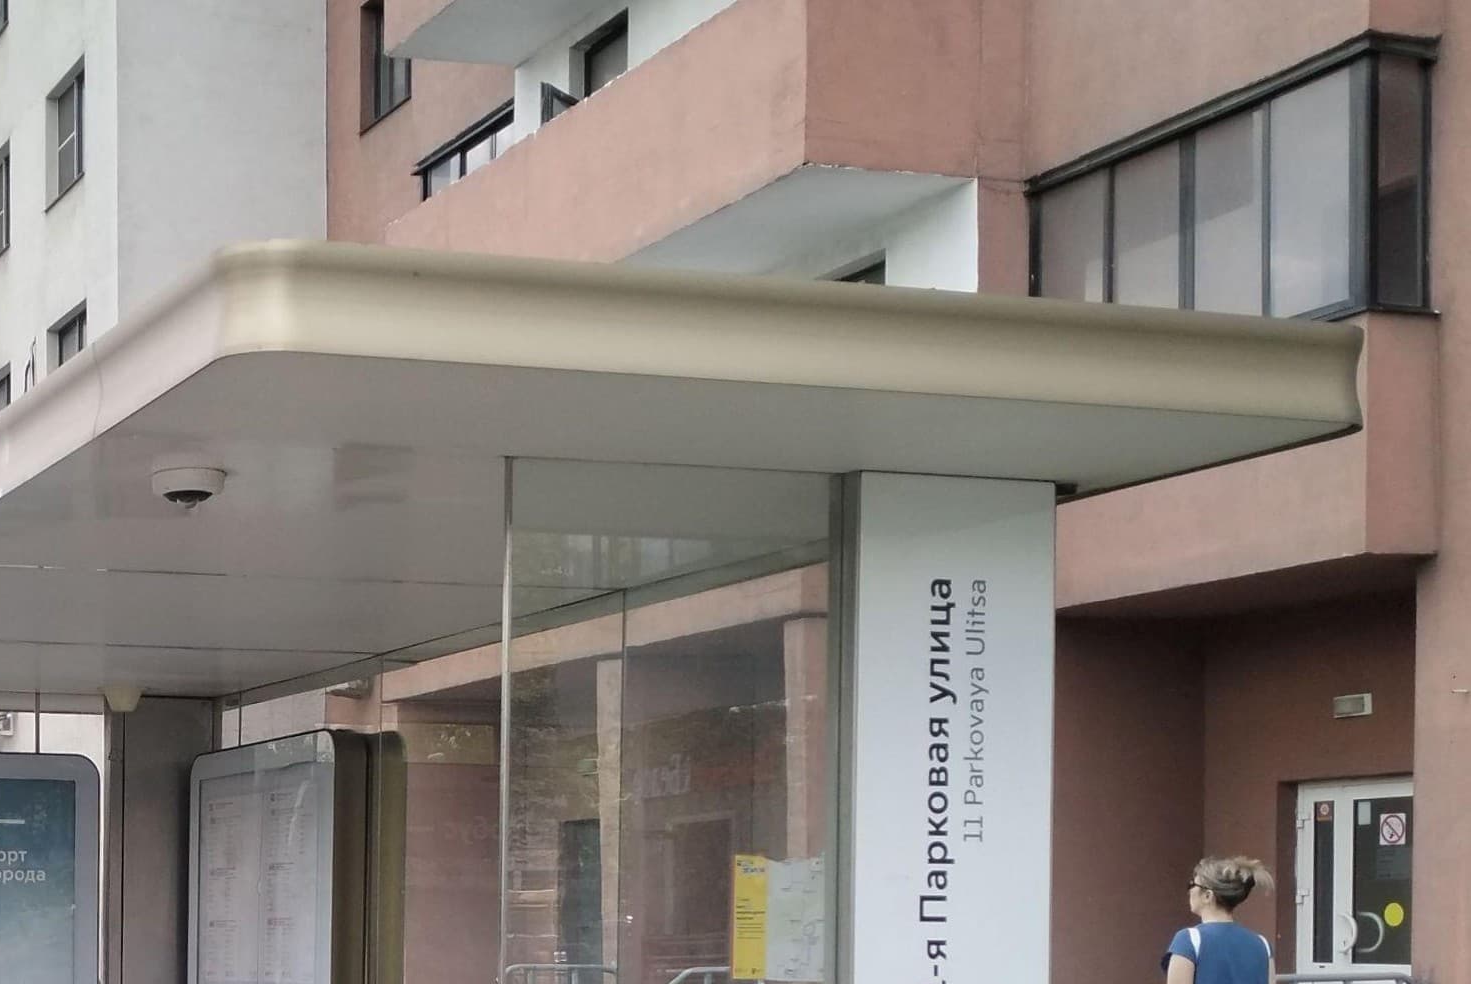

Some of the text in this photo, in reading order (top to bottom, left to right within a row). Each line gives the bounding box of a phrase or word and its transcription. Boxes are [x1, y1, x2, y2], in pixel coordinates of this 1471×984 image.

[929, 578, 958, 705] улица
[963, 578, 990, 843] 11 Parkovaya Ulitsa
[919, 717, 956, 923] Парковая
